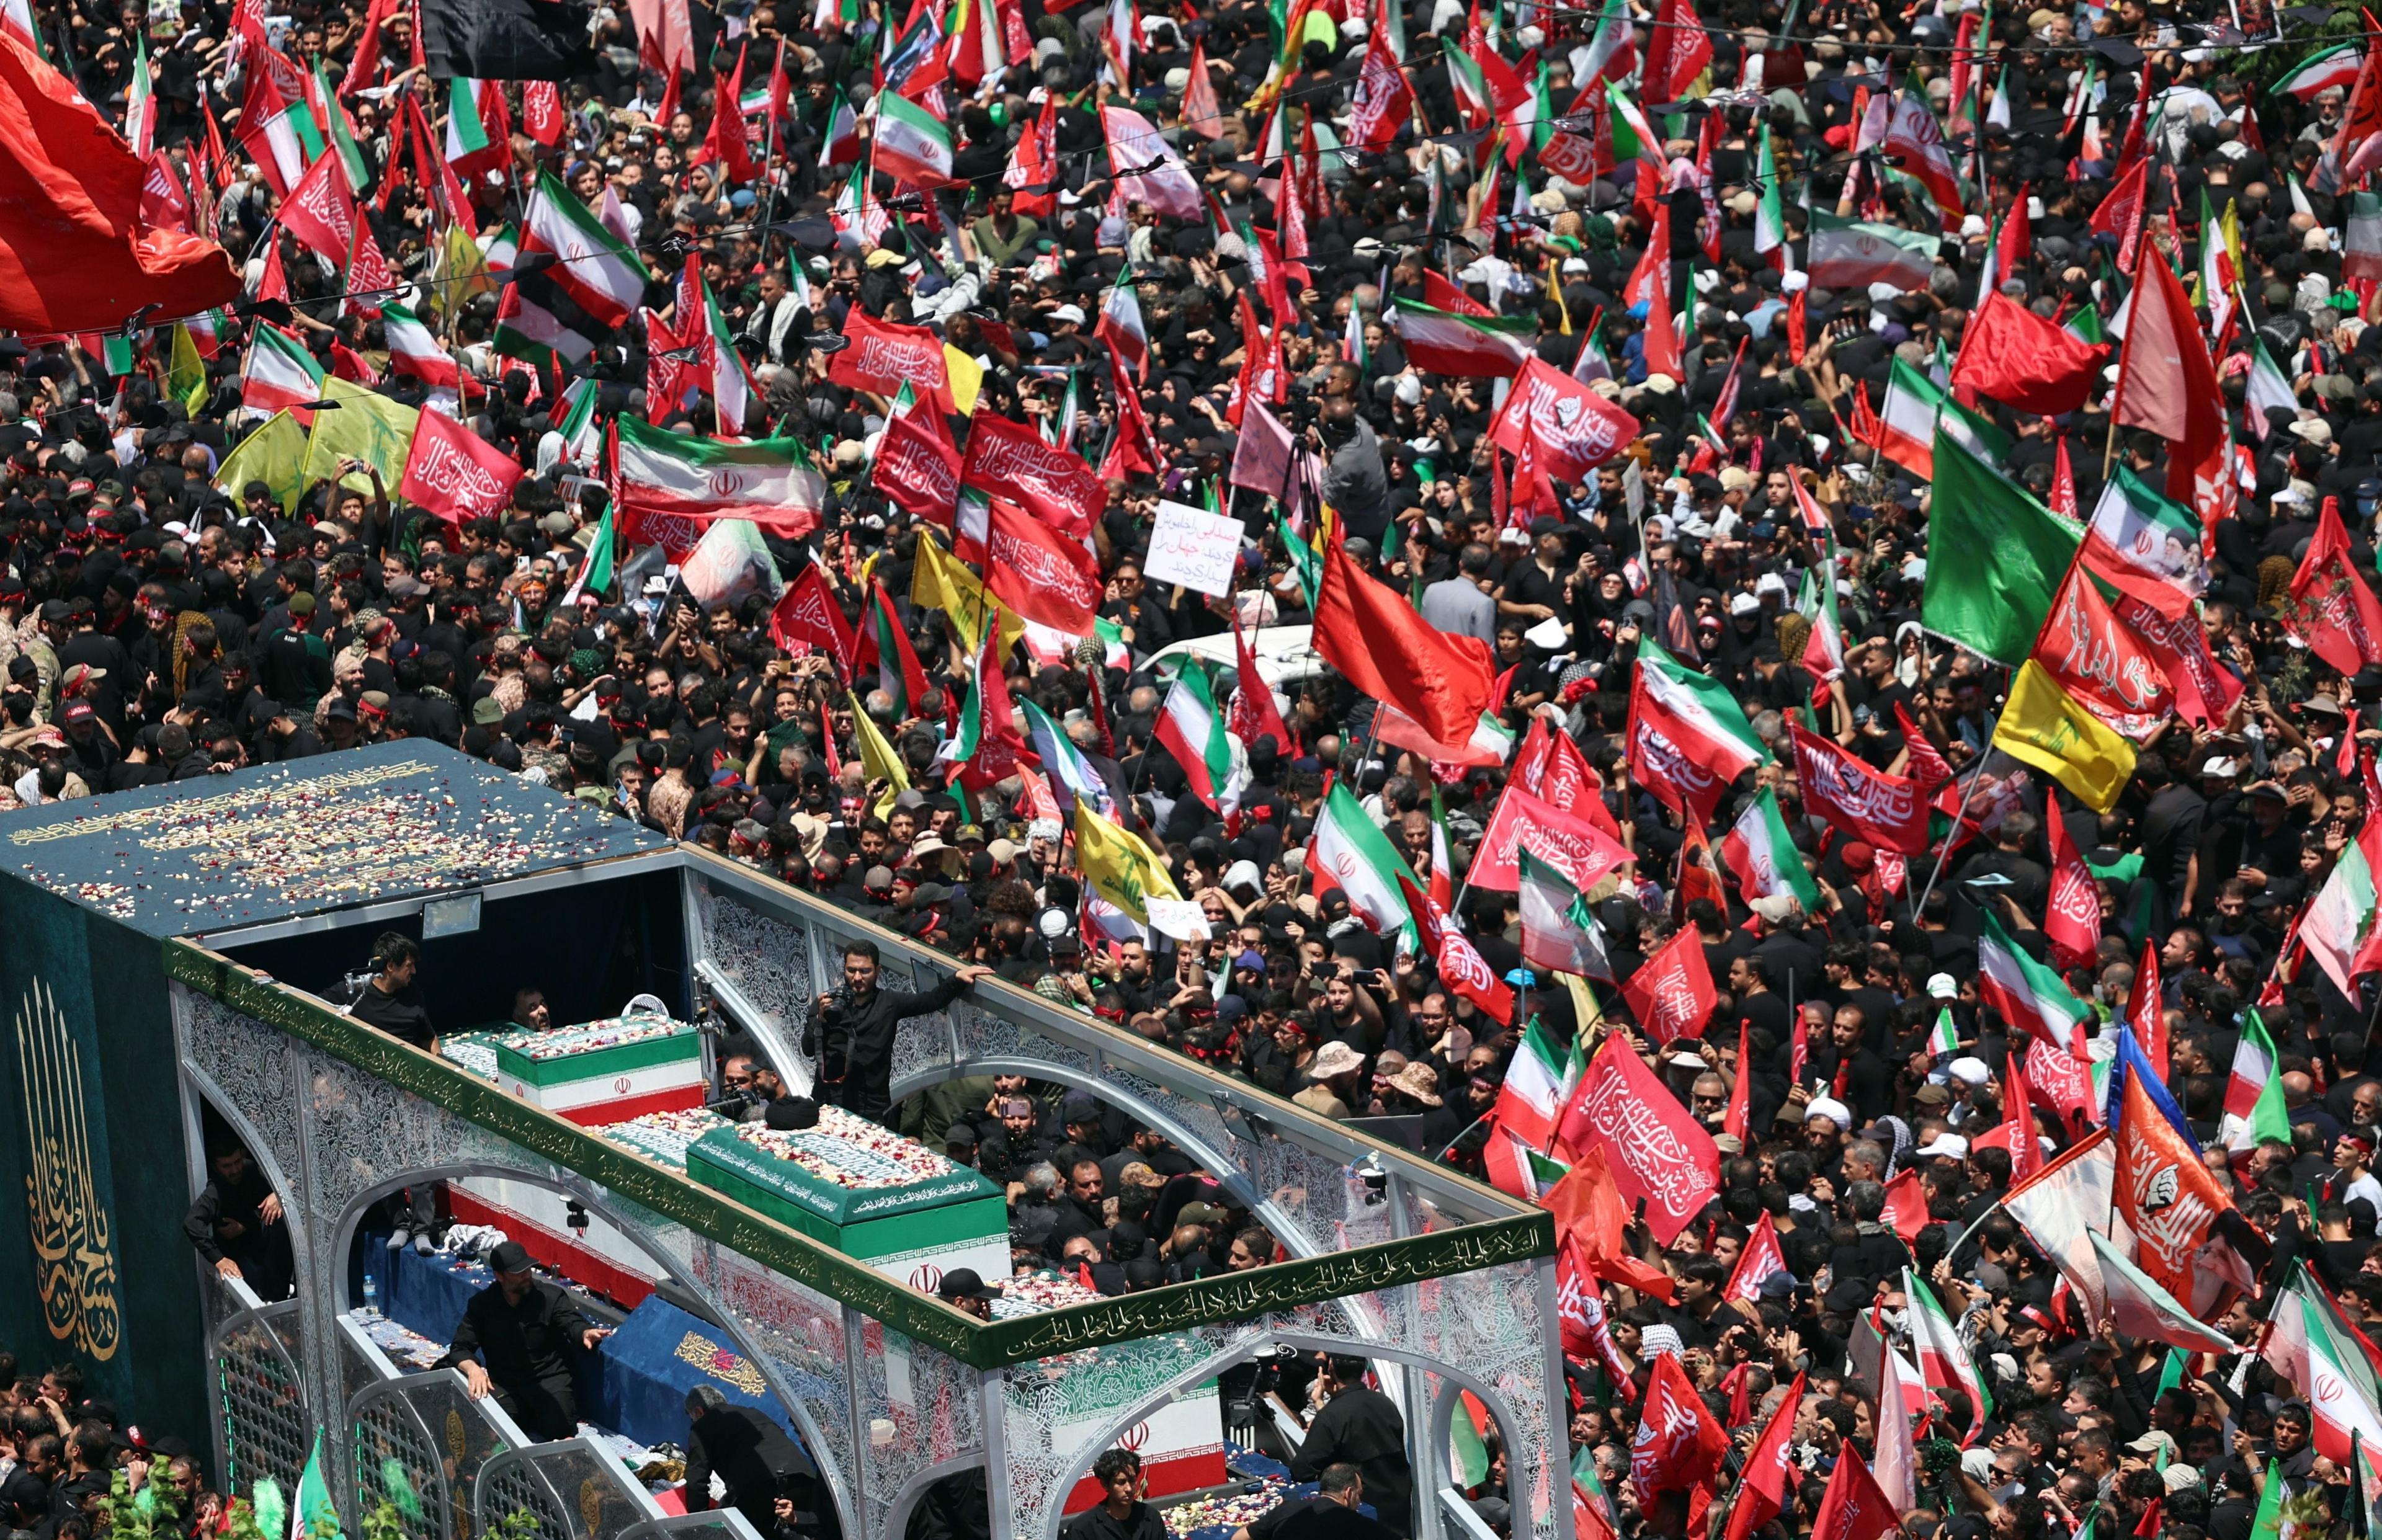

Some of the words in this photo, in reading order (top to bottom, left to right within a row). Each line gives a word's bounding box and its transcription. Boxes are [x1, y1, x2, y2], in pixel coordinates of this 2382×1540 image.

[1156, 510, 1190, 529] خاموش
[1154, 532, 1167, 550] را
[1166, 535, 1199, 557] جهان
[1197, 565, 1227, 586] بیدار
[1412, 1237, 1471, 1276] الحسين
[1276, 1262, 1336, 1303] الحسين
[1143, 1288, 1207, 1330] الحسين
[1006, 1317, 1073, 1357] الحسين
